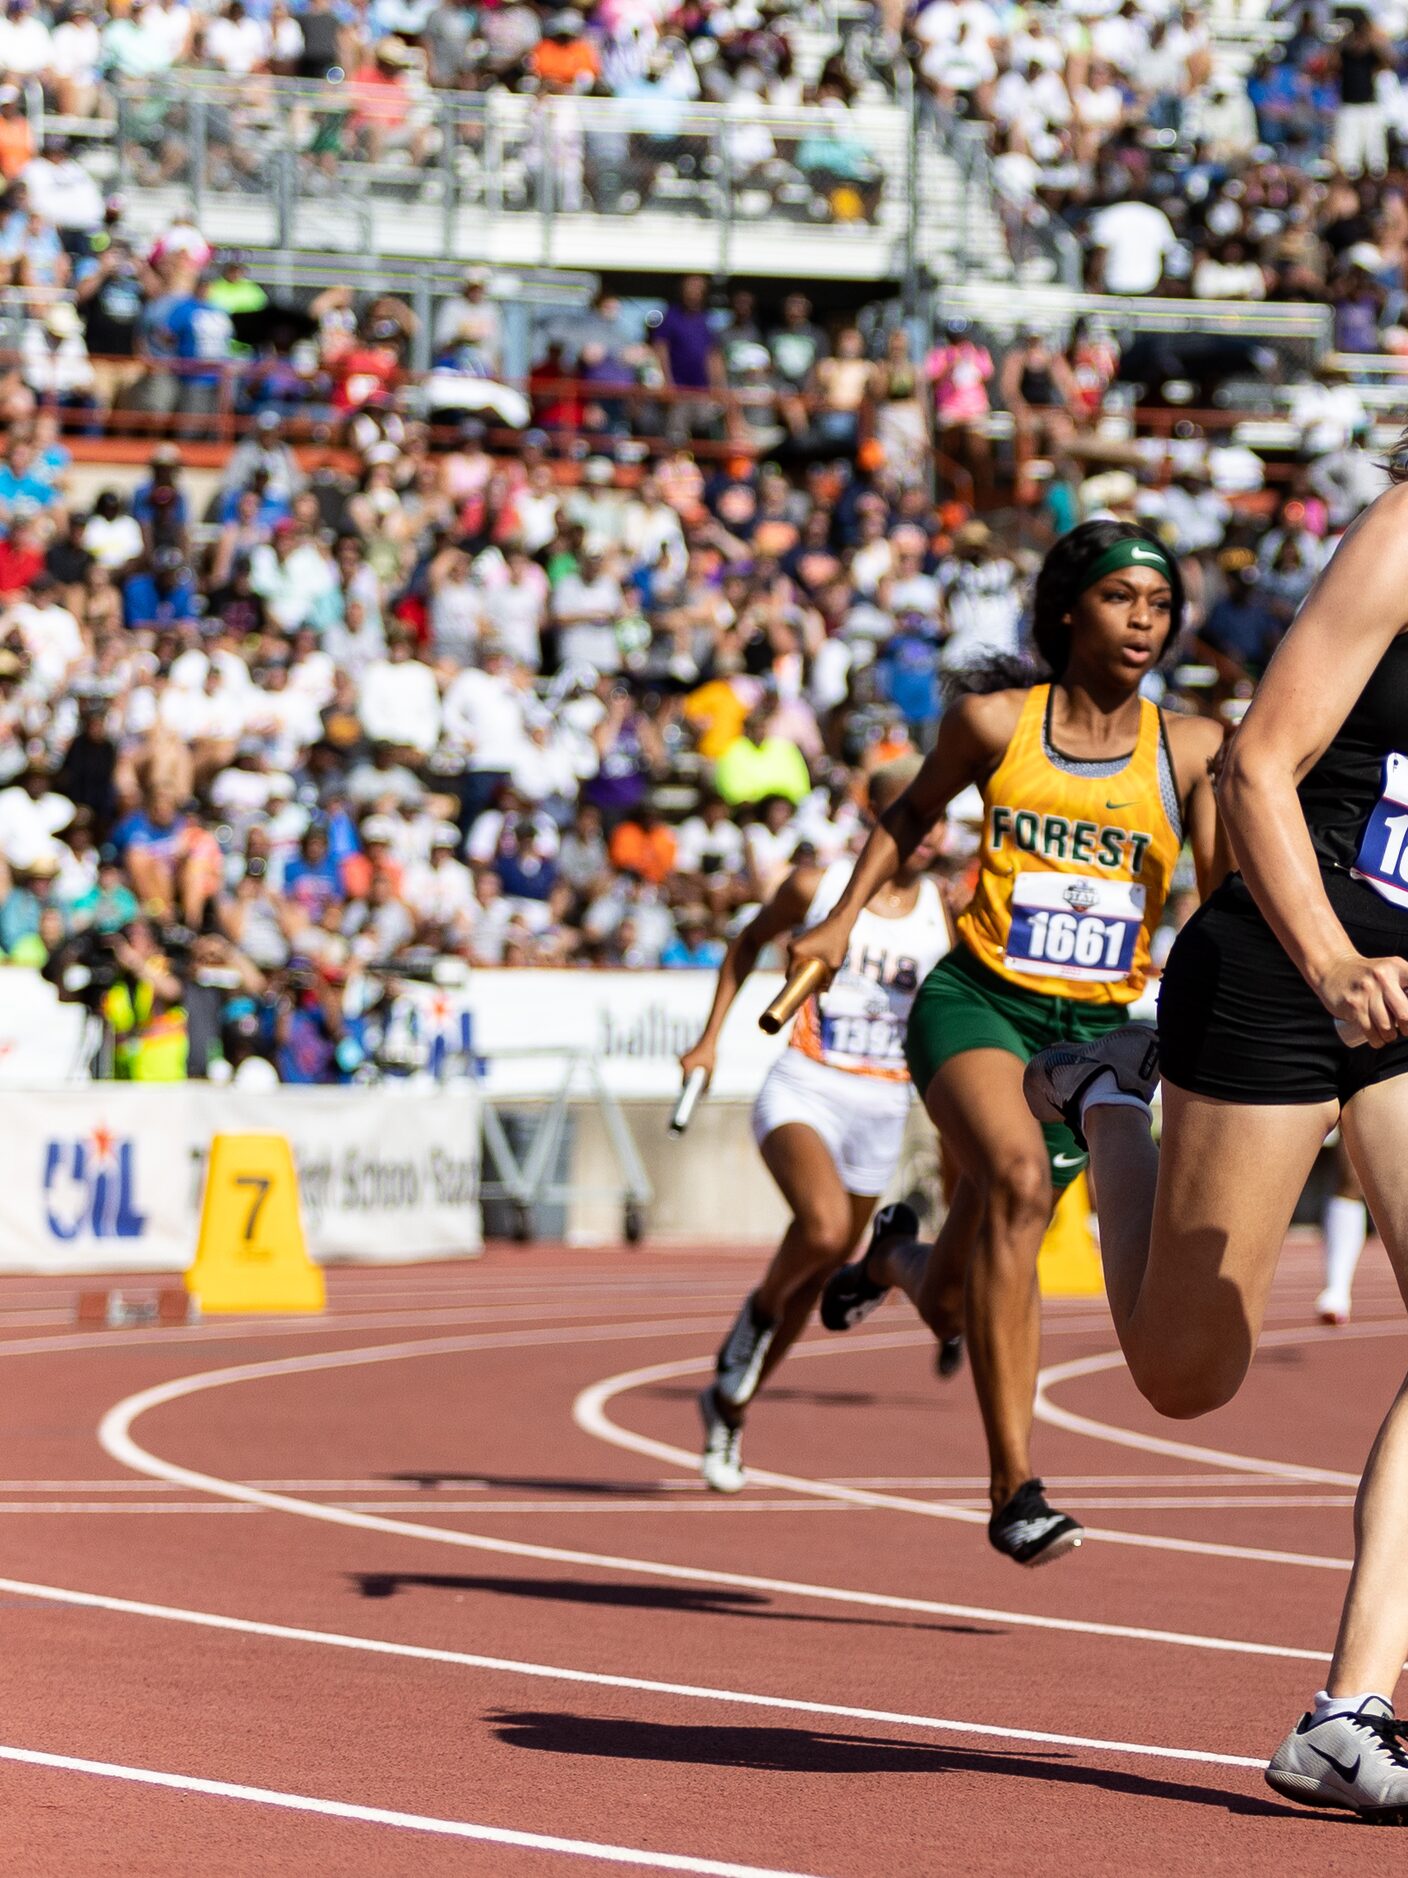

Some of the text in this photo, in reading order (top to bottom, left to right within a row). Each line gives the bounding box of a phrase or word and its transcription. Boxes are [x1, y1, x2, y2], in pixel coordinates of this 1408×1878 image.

[988, 805, 1152, 876] FOREST
[1027, 911, 1127, 968] 1661
[44, 1136, 147, 1239] UIL
[235, 1176, 271, 1240] 7
